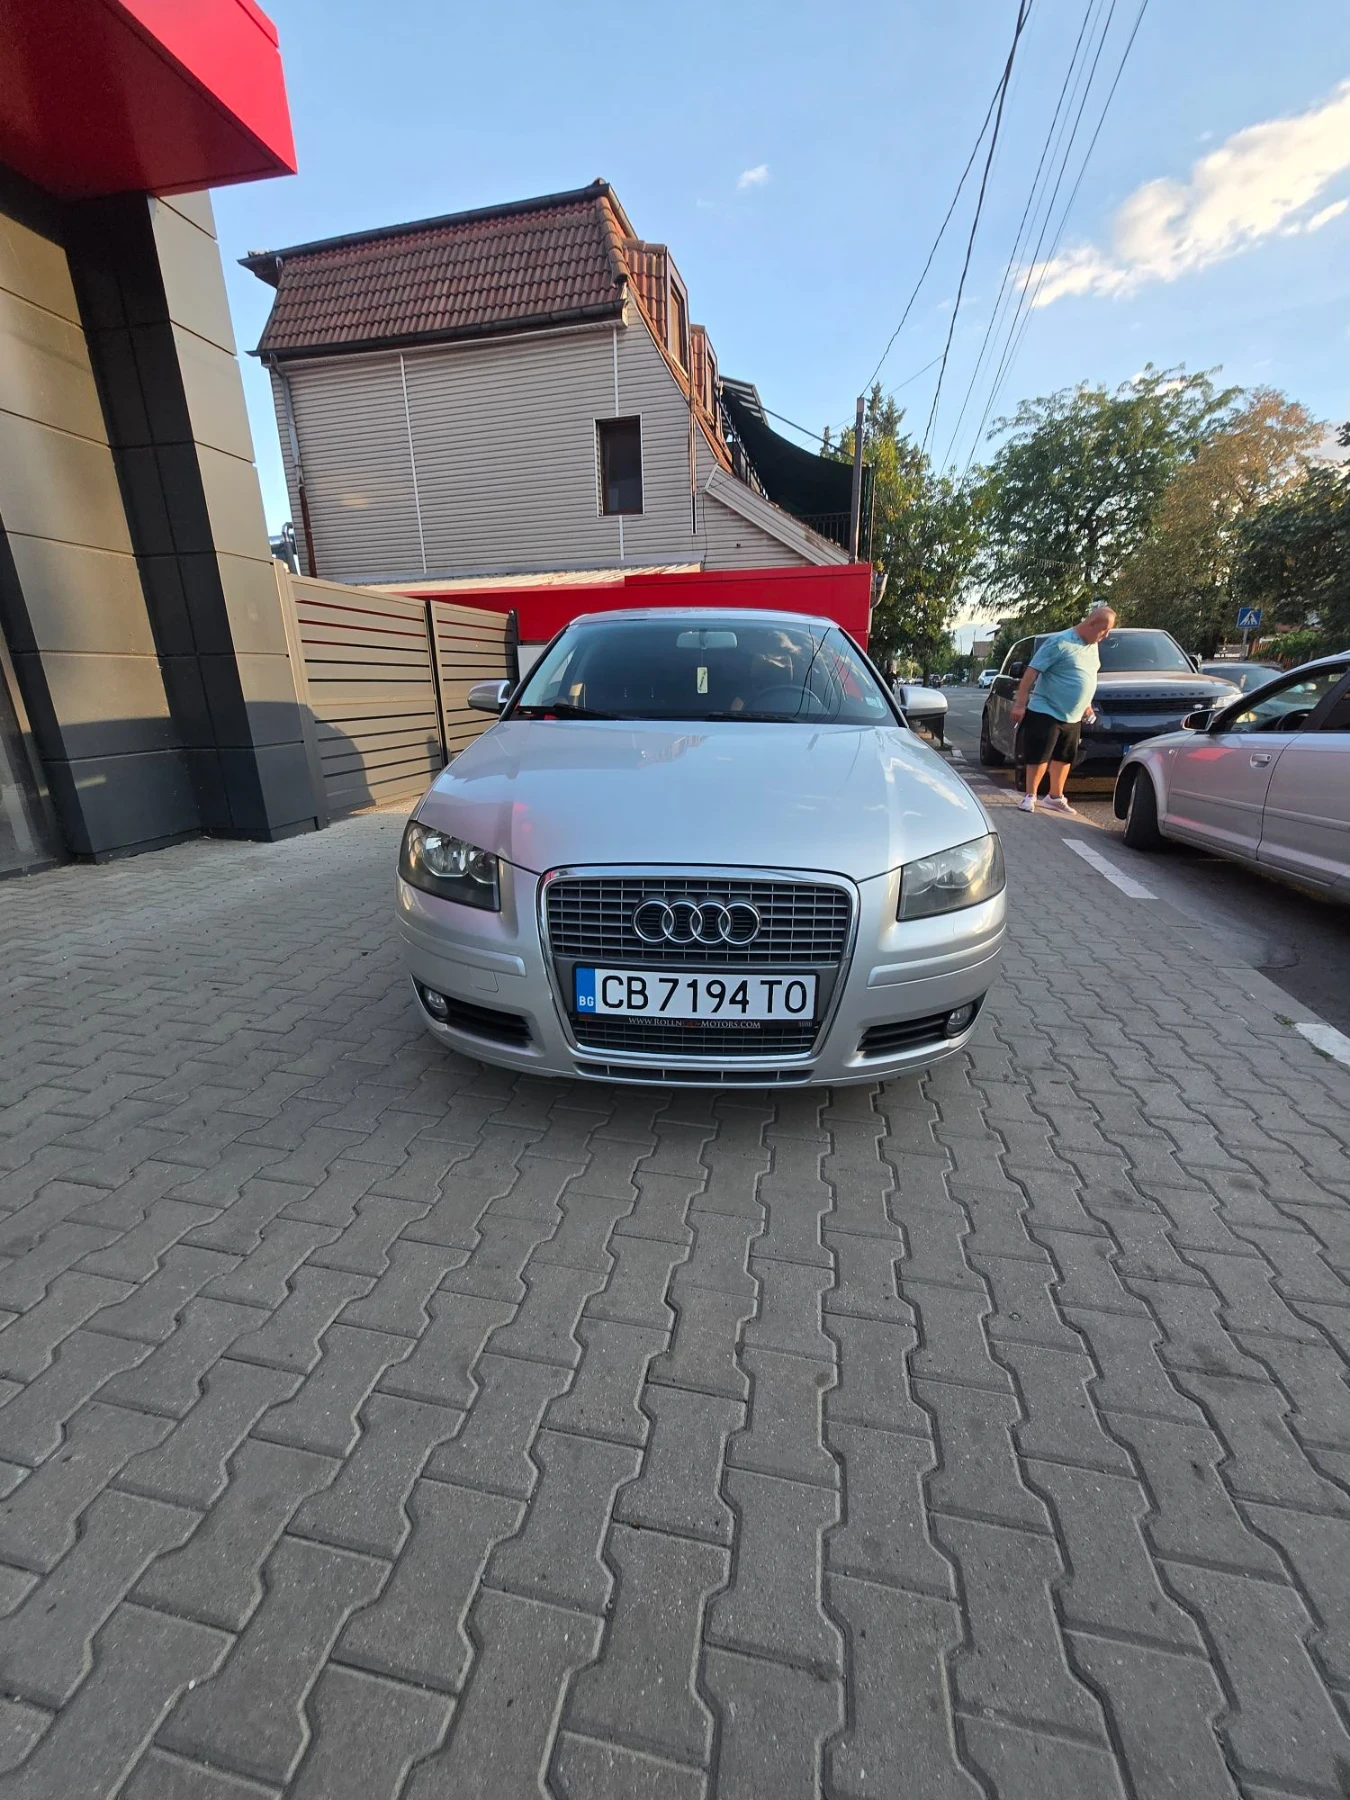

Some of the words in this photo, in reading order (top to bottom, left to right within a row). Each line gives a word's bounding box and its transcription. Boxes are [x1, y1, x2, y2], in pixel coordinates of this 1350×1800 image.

[579, 995, 594, 1007] BG
[601, 975, 649, 1010] CB
[658, 977, 750, 1013] 7194
